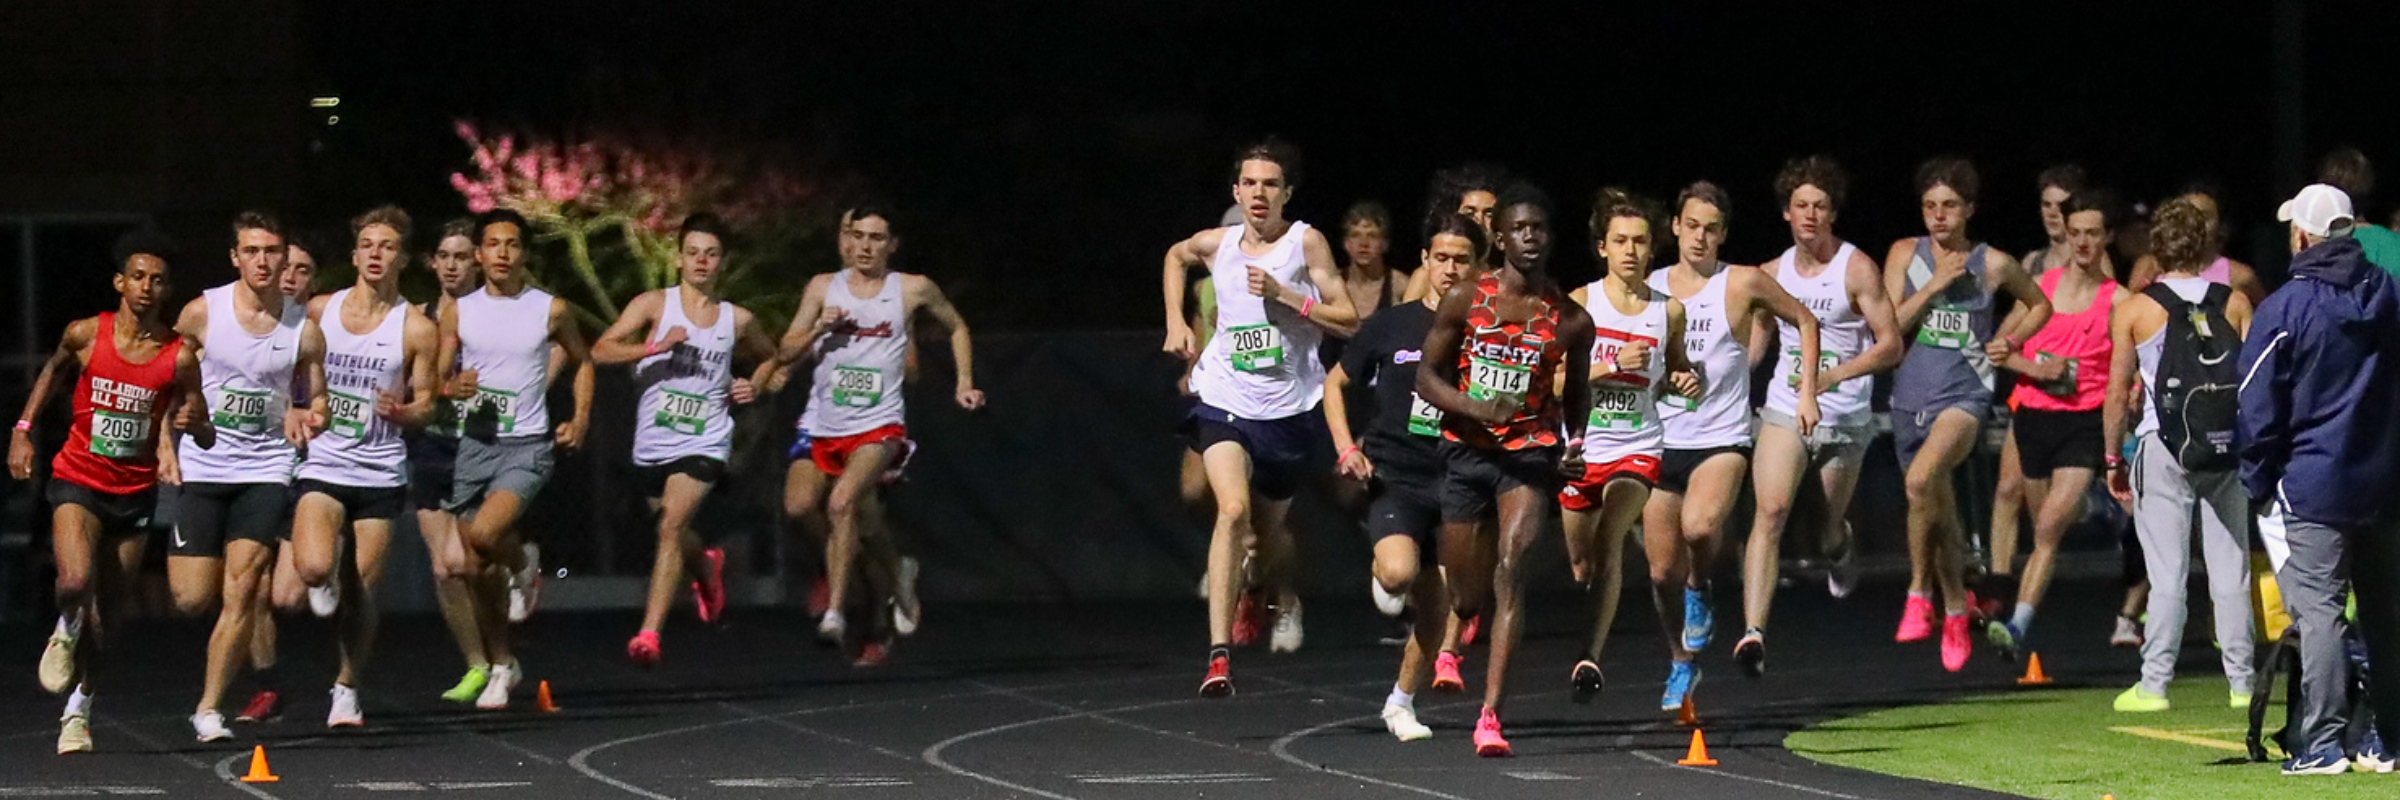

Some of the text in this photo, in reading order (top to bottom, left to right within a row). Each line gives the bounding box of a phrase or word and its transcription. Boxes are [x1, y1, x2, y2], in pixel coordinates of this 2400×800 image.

[1233, 328, 1271, 351] 2087
[325, 351, 388, 373] OUTHLAKE
[1471, 339, 1541, 365] KENYA
[838, 370, 874, 390] 2089
[1479, 365, 1521, 391] 2114
[91, 391, 113, 407] ALL
[223, 393, 266, 416] 2109
[328, 397, 360, 420] 094
[664, 393, 703, 417] 2107
[1596, 390, 1636, 411] 2092
[100, 418, 143, 439] 2091
